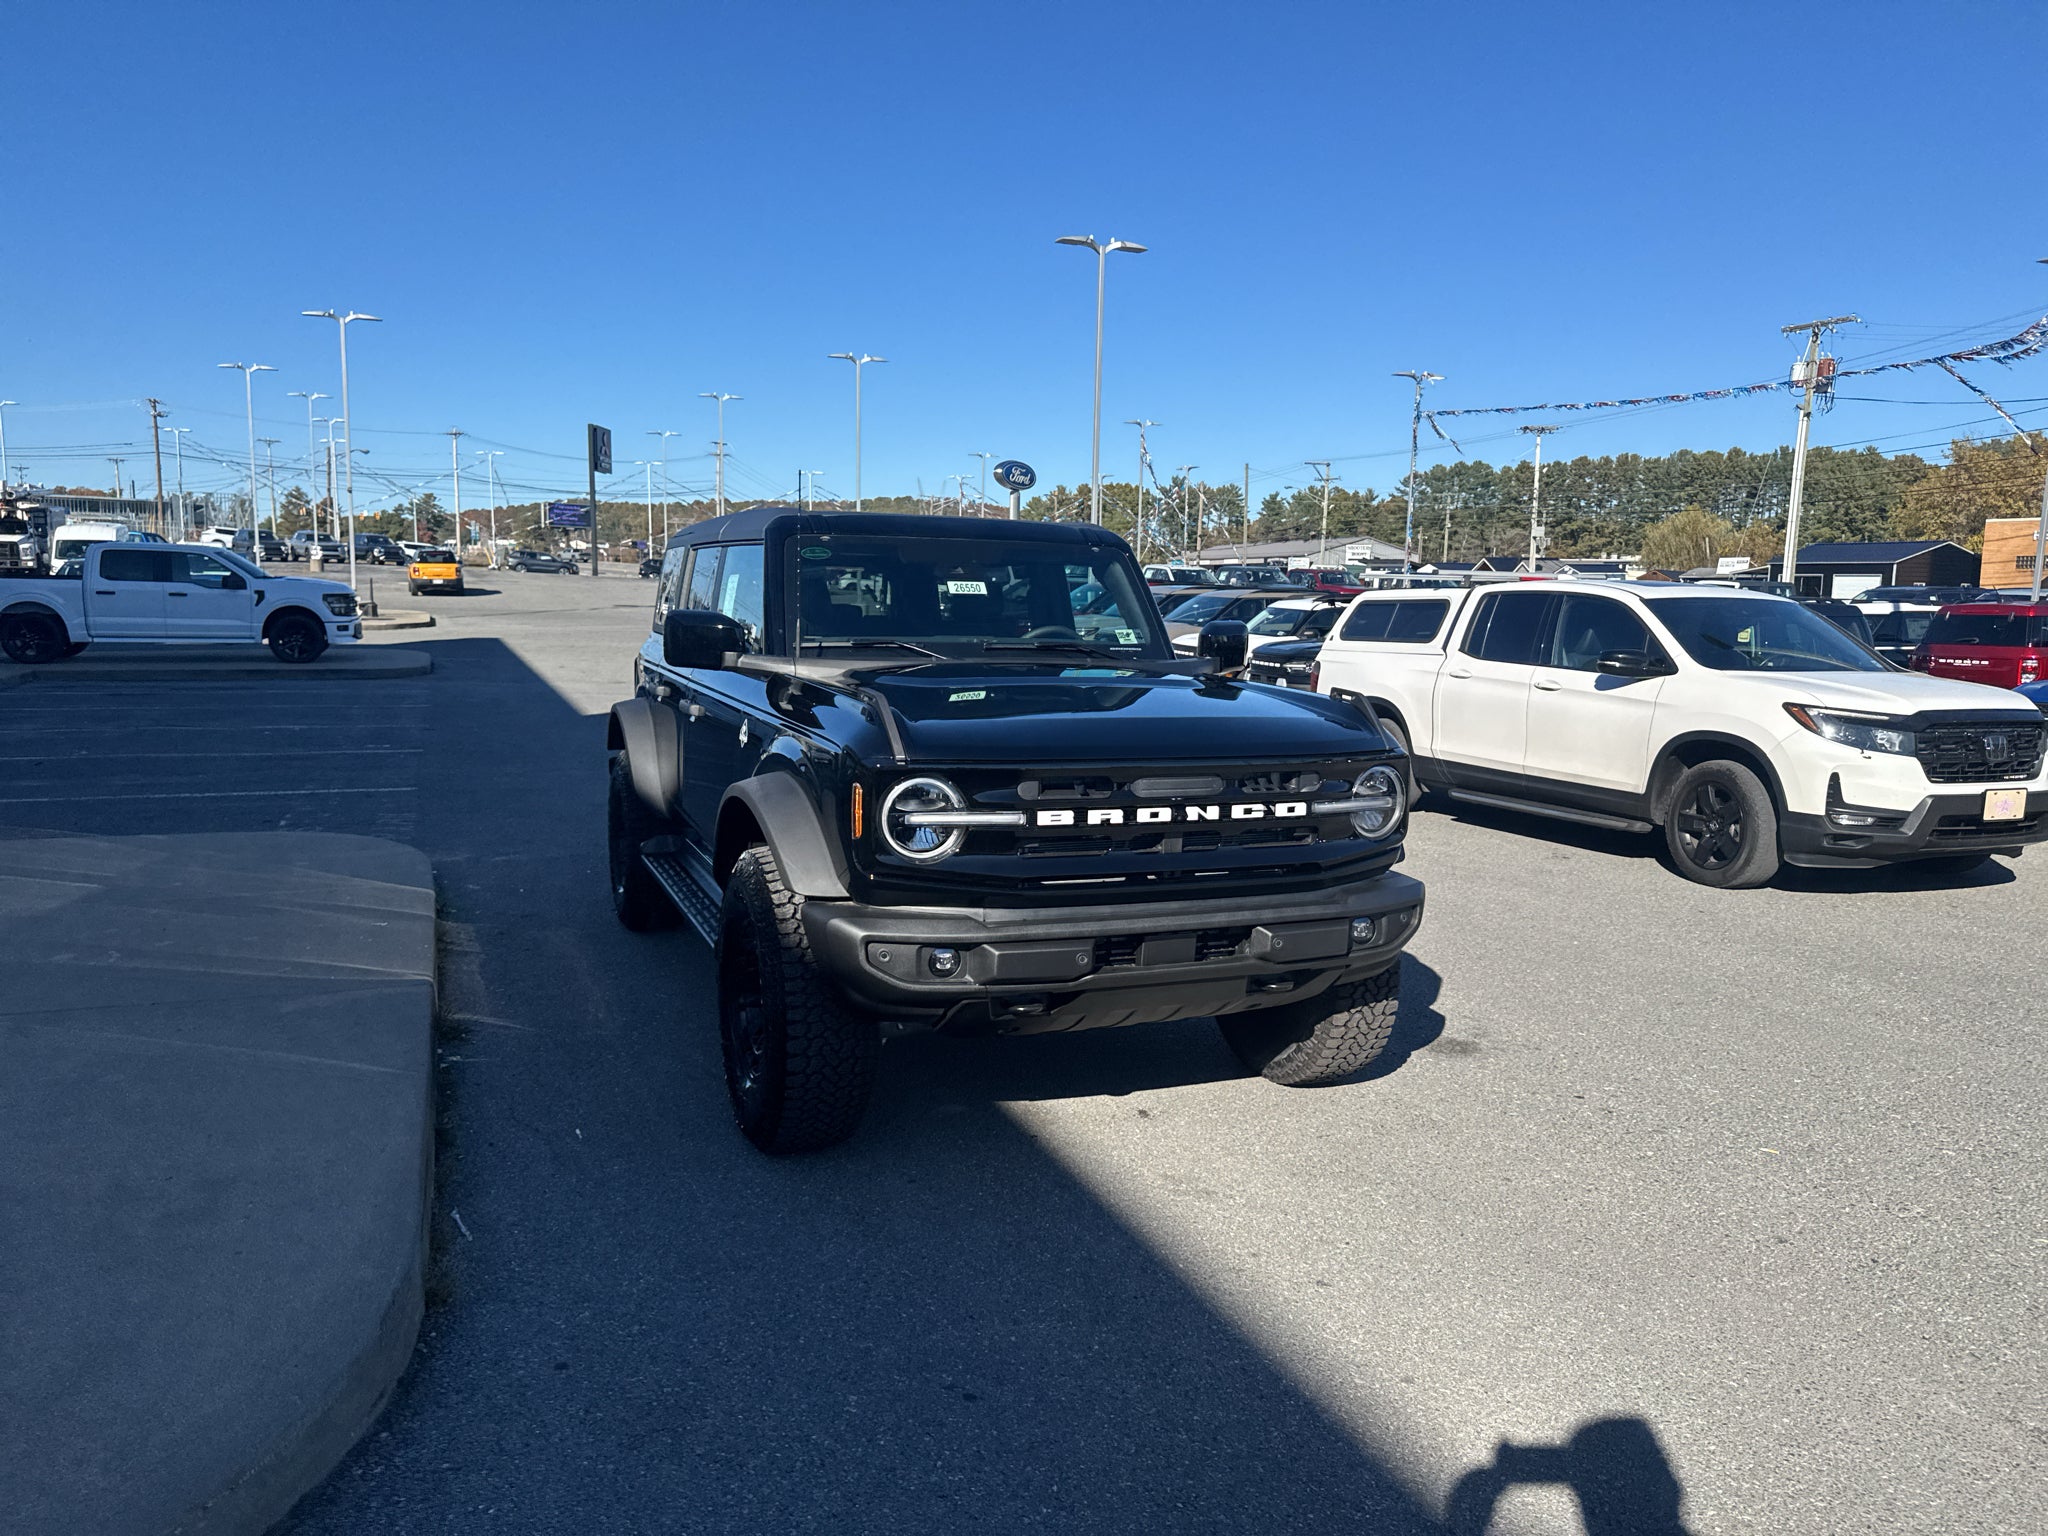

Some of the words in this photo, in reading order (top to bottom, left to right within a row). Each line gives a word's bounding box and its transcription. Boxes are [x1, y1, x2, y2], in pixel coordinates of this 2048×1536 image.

[1010, 466, 1030, 485] Ford
[953, 583, 982, 593] 26550
[1036, 801, 1307, 826] BRONCO
